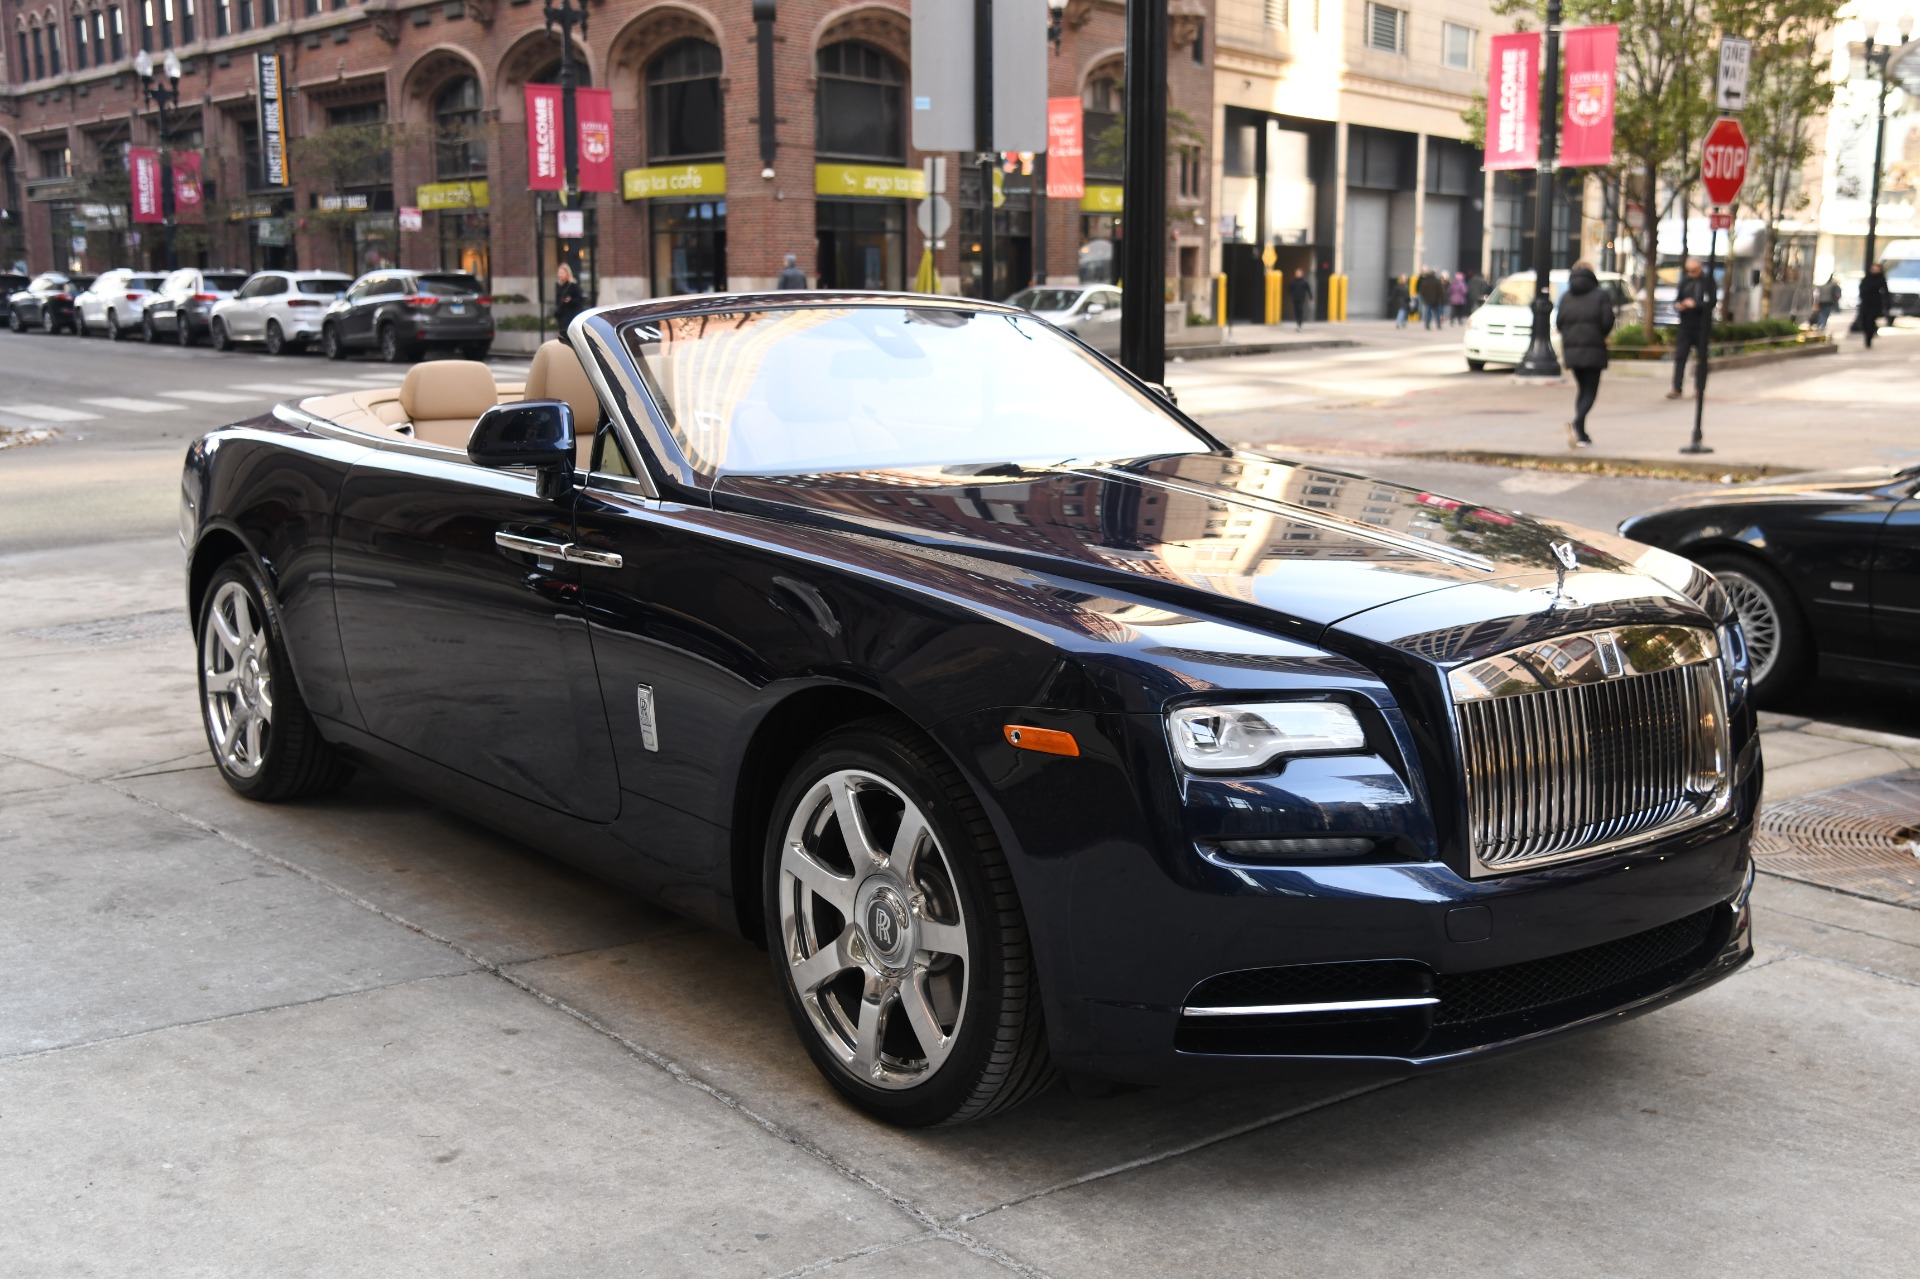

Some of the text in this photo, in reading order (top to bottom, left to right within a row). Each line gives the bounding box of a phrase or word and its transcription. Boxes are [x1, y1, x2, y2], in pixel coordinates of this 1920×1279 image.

[1723, 46, 1745, 63] ONE
[261, 55, 279, 99] BAGELS
[1722, 65, 1744, 82] WAY
[1499, 48, 1519, 153] WELCOME
[534, 96, 550, 178] WELCOME
[267, 133, 283, 184] EINSTEIN
[1704, 144, 1744, 180] STOP
[136, 158, 151, 214] WELCOME
[669, 166, 702, 189] café
[863, 175, 893, 194] argo
[876, 908, 891, 944] RR
